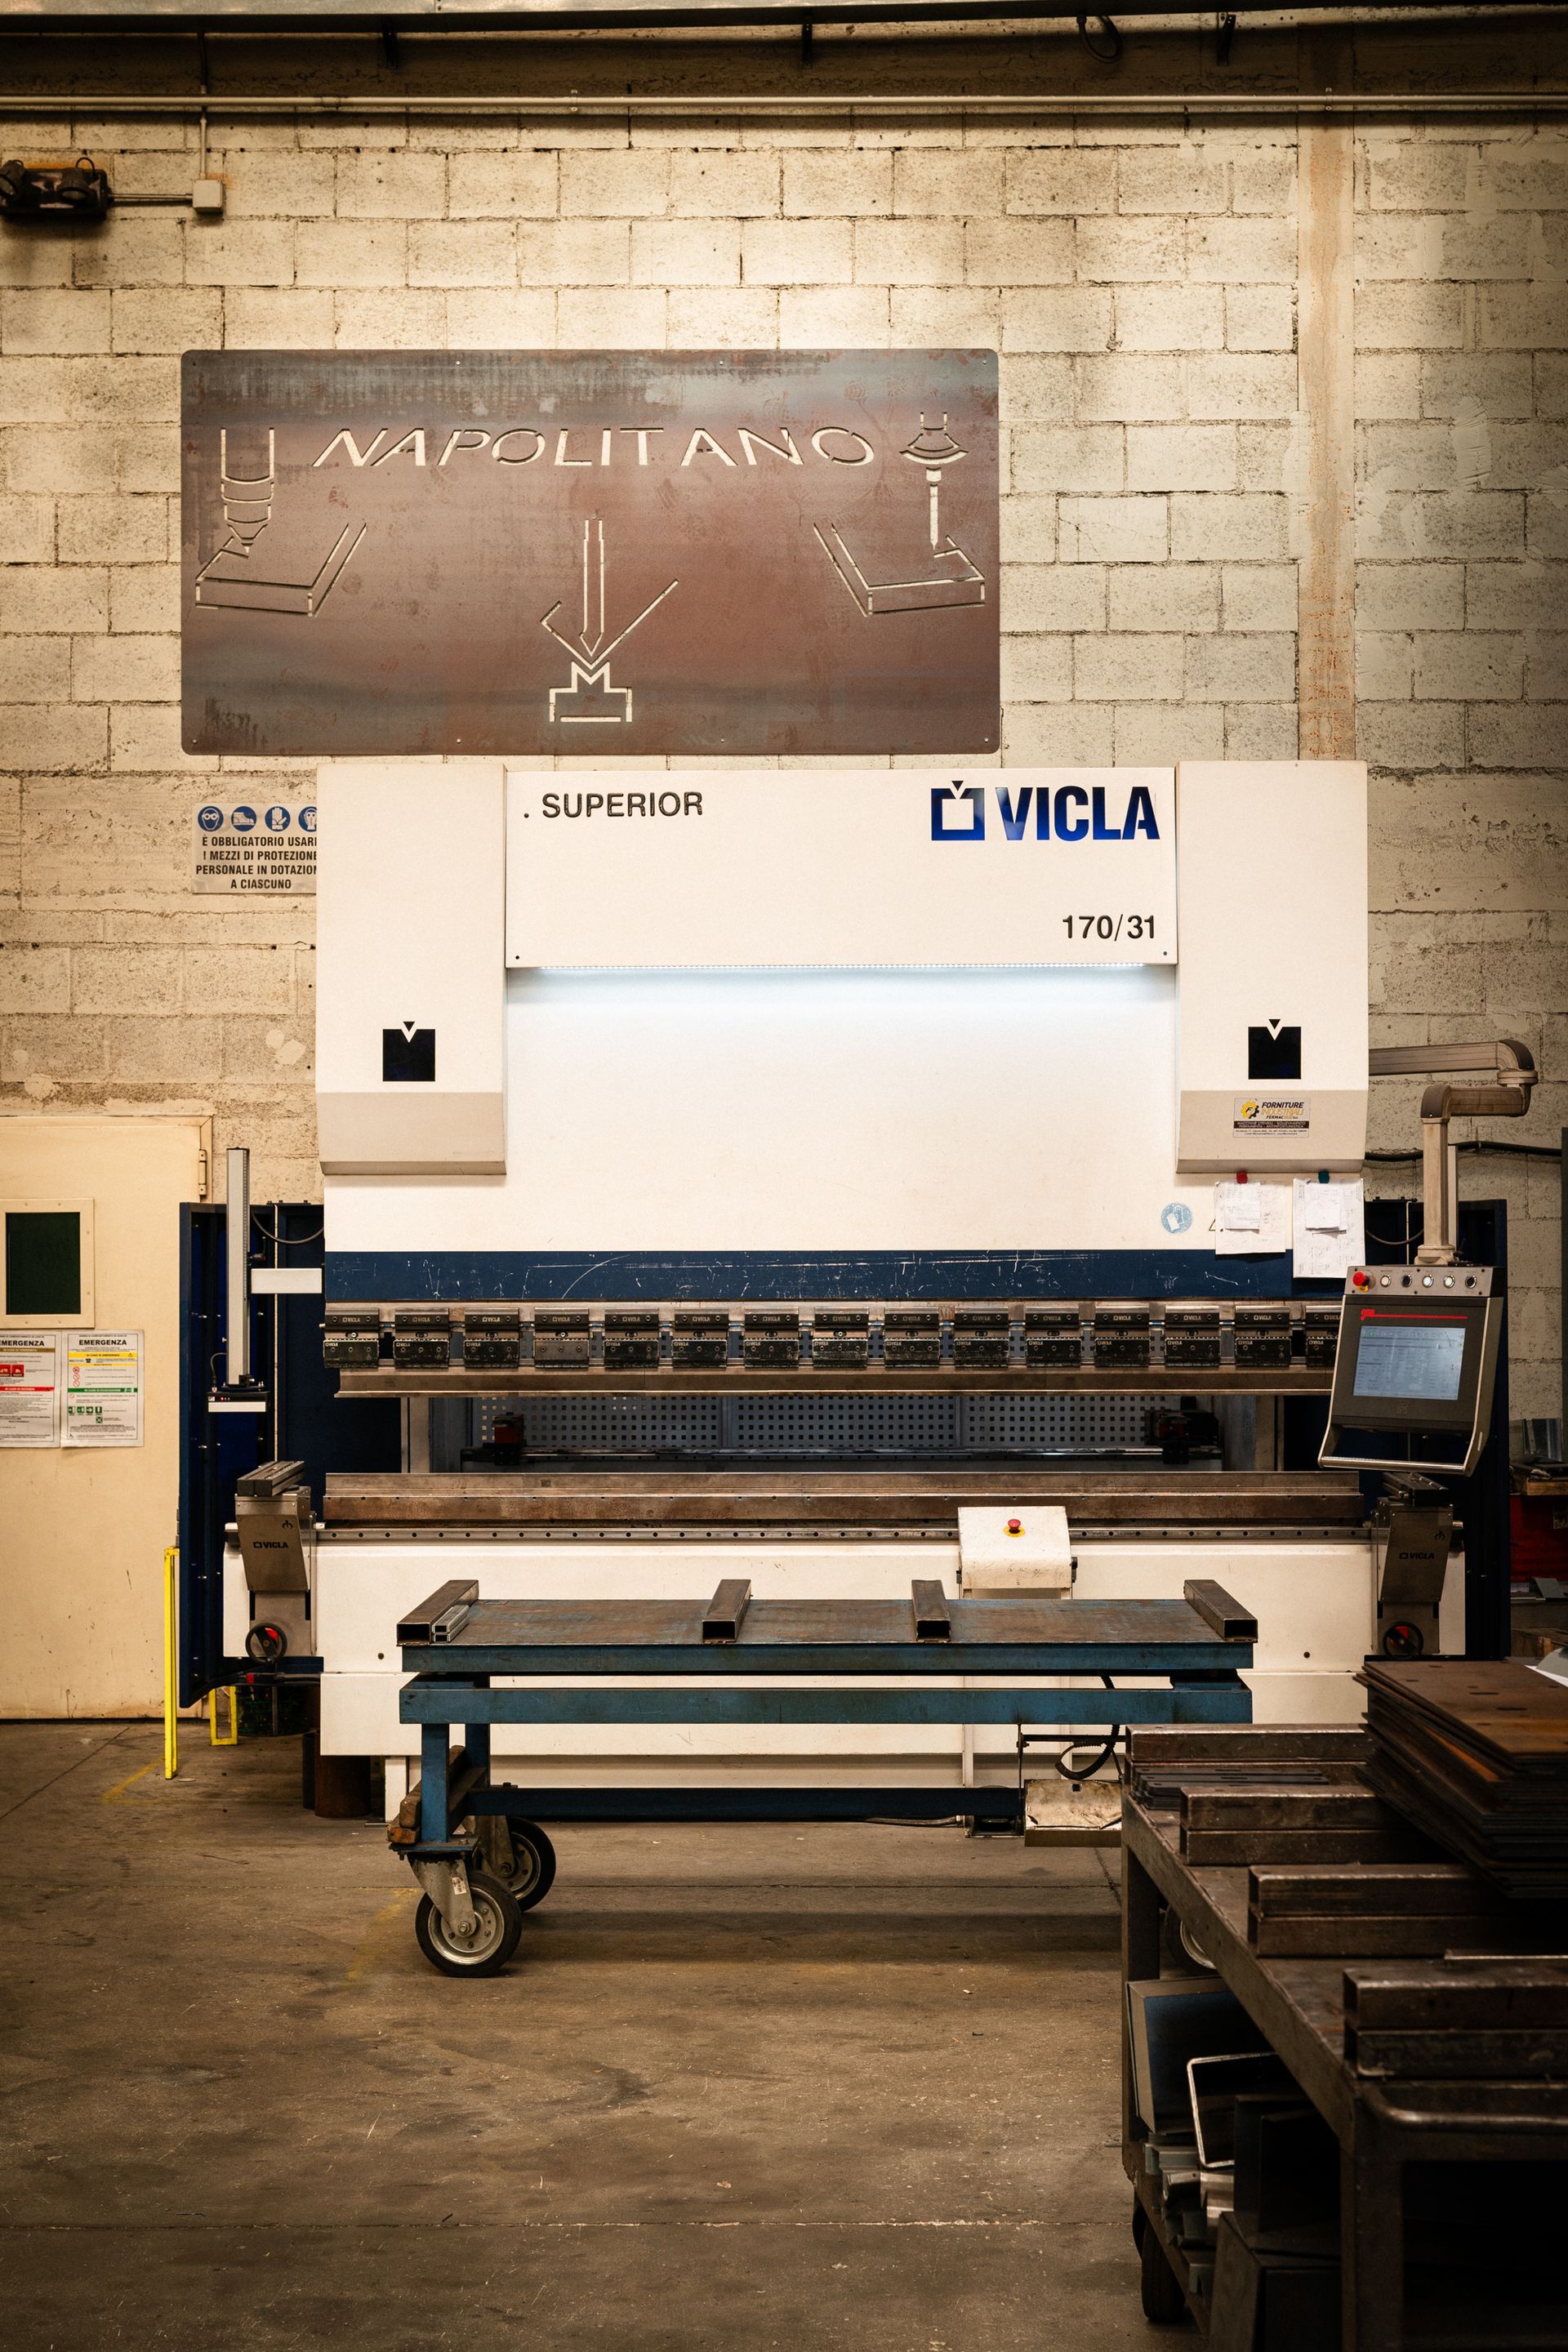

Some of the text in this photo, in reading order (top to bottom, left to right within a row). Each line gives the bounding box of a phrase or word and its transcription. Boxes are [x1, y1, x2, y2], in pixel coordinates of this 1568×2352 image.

[311, 426, 875, 466] NAPOLITANO
[542, 791, 702, 817] SUPERIOR
[995, 786, 1160, 841] VICLA
[211, 836, 284, 847] OBBLIGATORIO
[203, 851, 207, 861] I
[210, 851, 240, 861] MEZZI
[243, 851, 254, 861] DI
[196, 865, 254, 875] PERSONALE
[257, 865, 267, 875] IN
[230, 879, 292, 889] A CIASCUNO
[1062, 914, 1155, 942] 170/31
